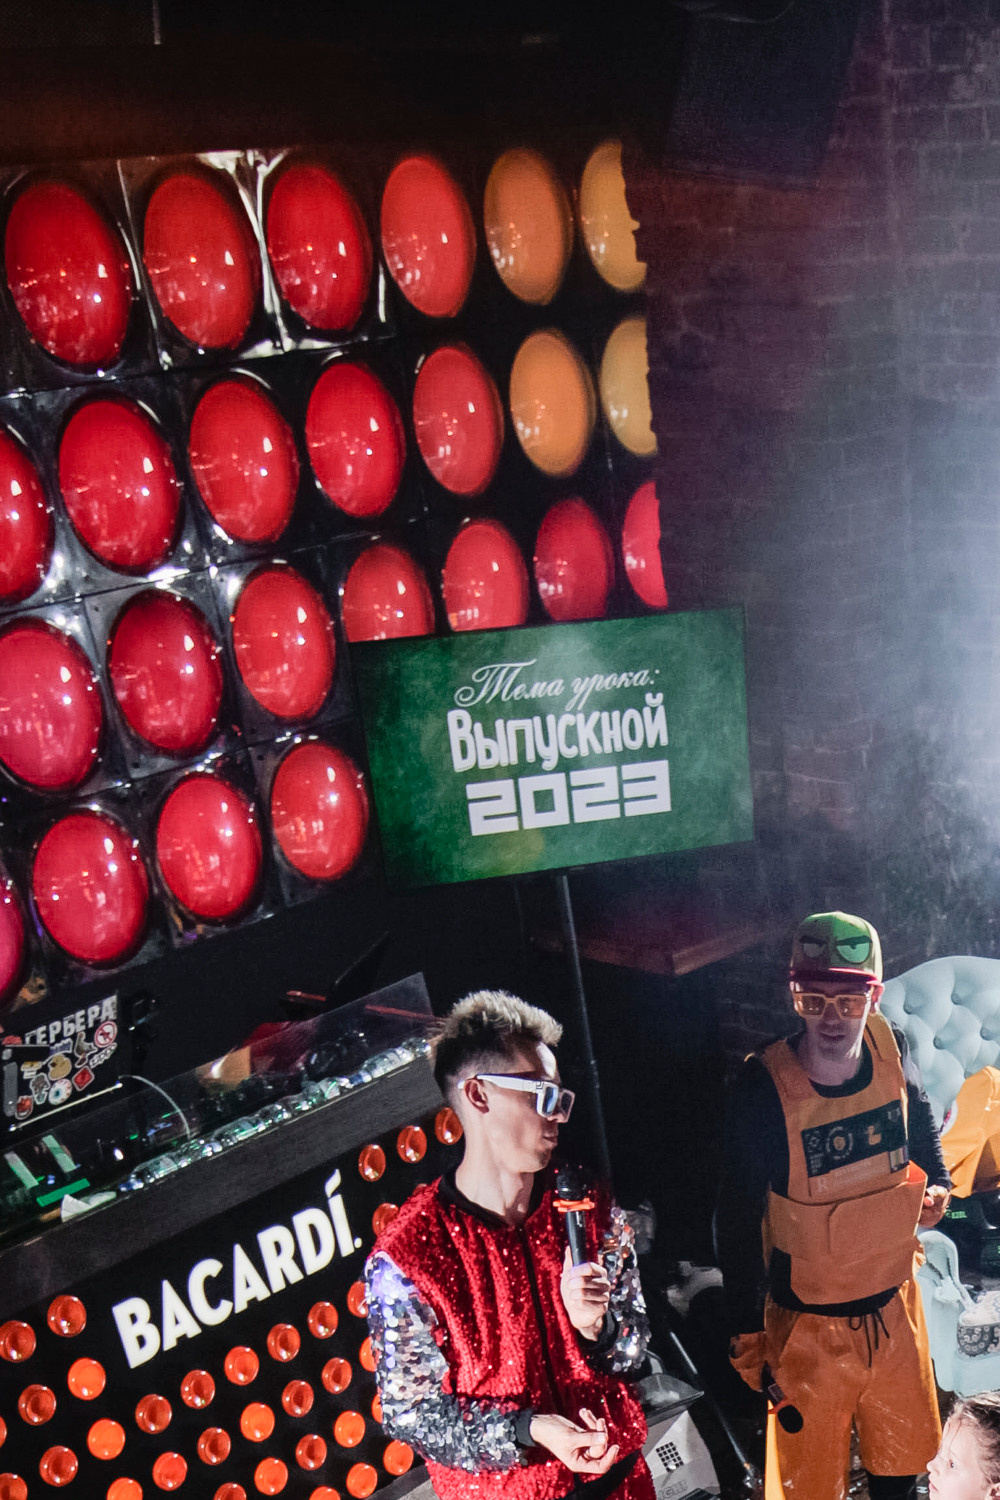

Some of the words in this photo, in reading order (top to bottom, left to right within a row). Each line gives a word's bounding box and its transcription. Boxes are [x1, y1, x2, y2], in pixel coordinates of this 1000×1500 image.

[453, 659, 564, 708] Тема
[566, 668, 661, 711] урока:
[447, 692, 669, 773] Выпускной
[466, 760, 672, 837] 2023
[25, 995, 117, 1045] ГЕРБЕРА
